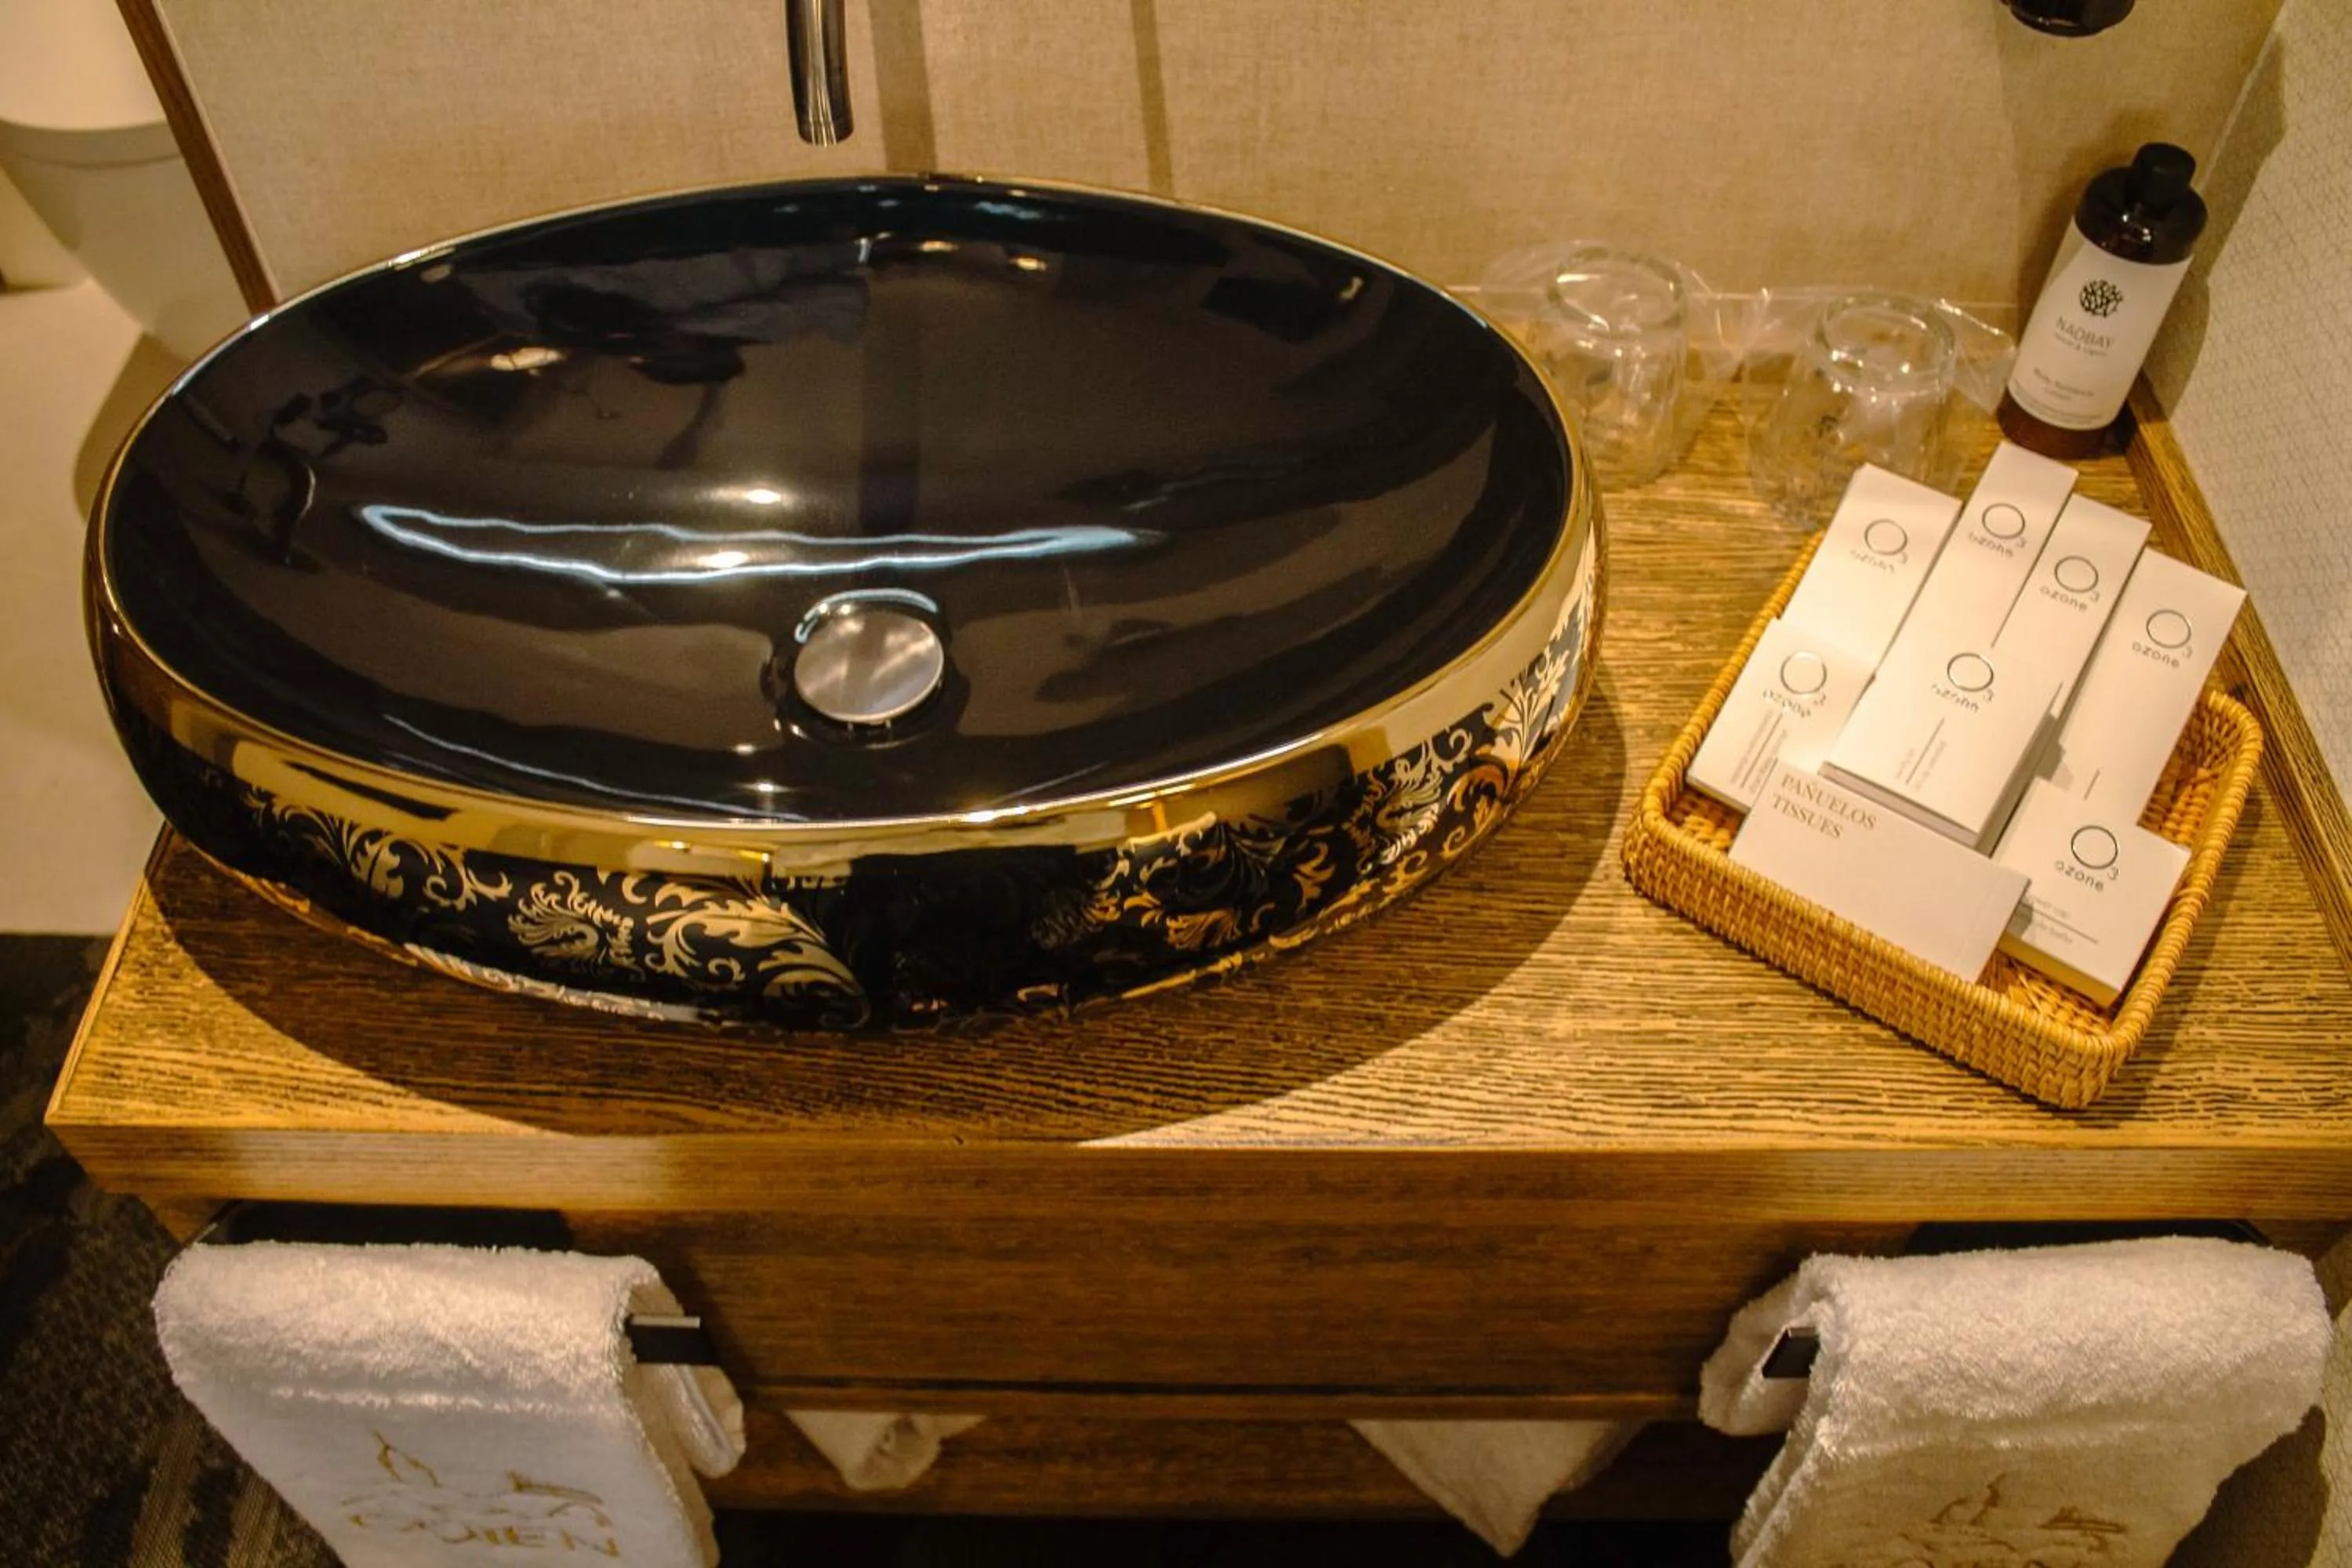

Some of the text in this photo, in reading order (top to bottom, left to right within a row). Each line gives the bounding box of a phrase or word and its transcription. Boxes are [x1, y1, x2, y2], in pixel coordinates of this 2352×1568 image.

[2040, 586, 2088, 612] ozone
[2132, 641, 2180, 669] ozone
[1773, 793, 1842, 838] TISSUES
[2055, 860, 2104, 891] ozone
